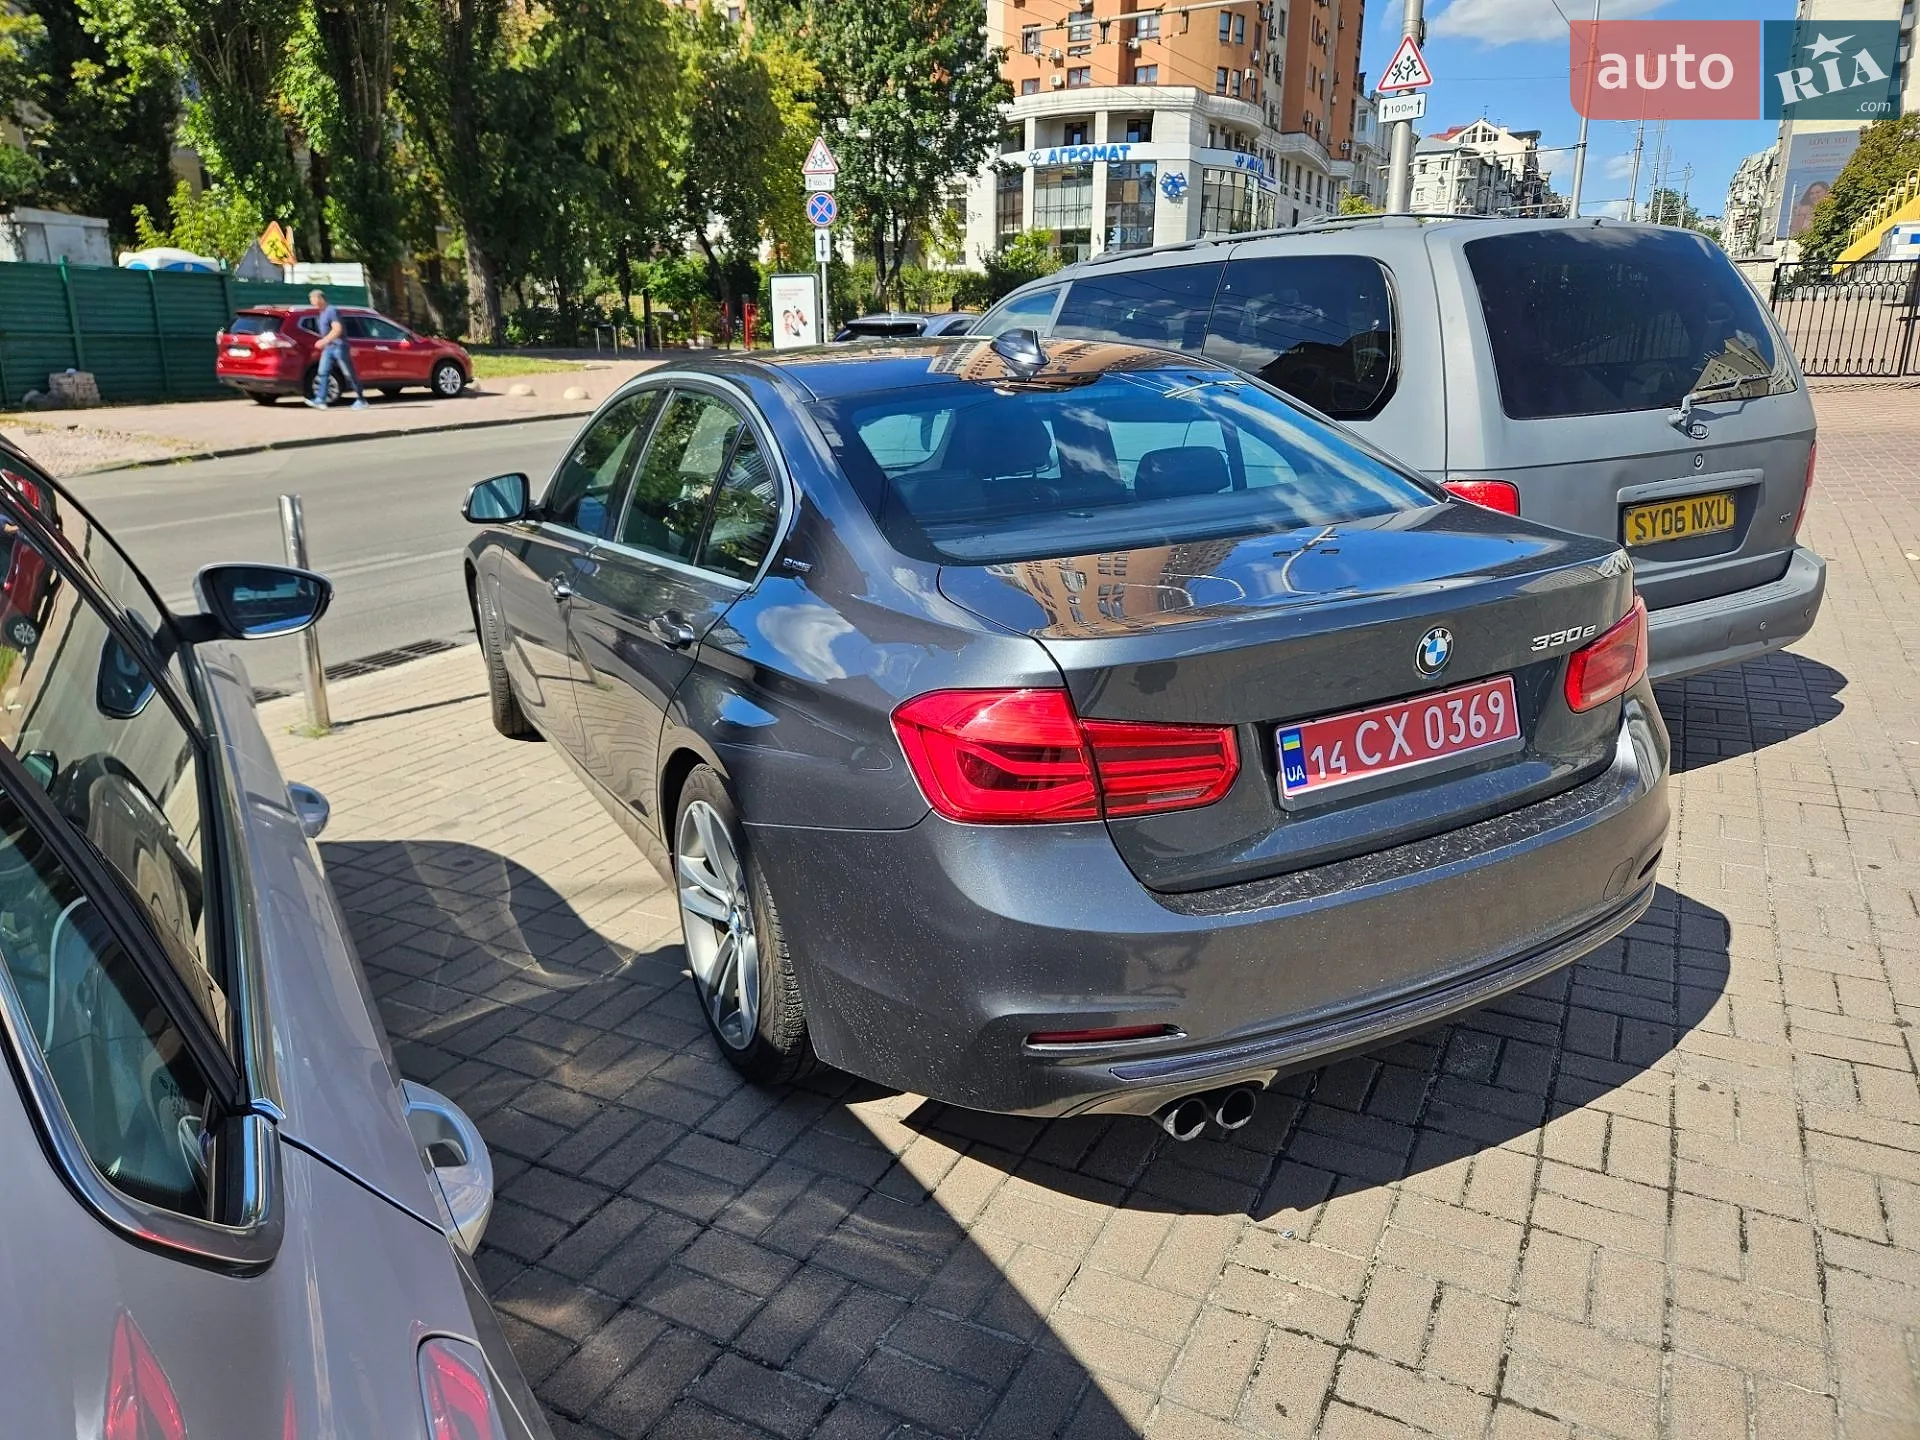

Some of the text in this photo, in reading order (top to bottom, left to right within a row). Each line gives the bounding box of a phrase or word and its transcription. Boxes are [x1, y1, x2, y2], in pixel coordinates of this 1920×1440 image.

[1048, 145, 1131, 164] АГРОМАТ
[1635, 498, 1728, 541] SY06 NXU
[1423, 630, 1453, 647] BMW
[1530, 625, 1597, 652] 330e
[1310, 690, 1505, 779] 14 CX 0369
[1286, 765, 1305, 782] UA
